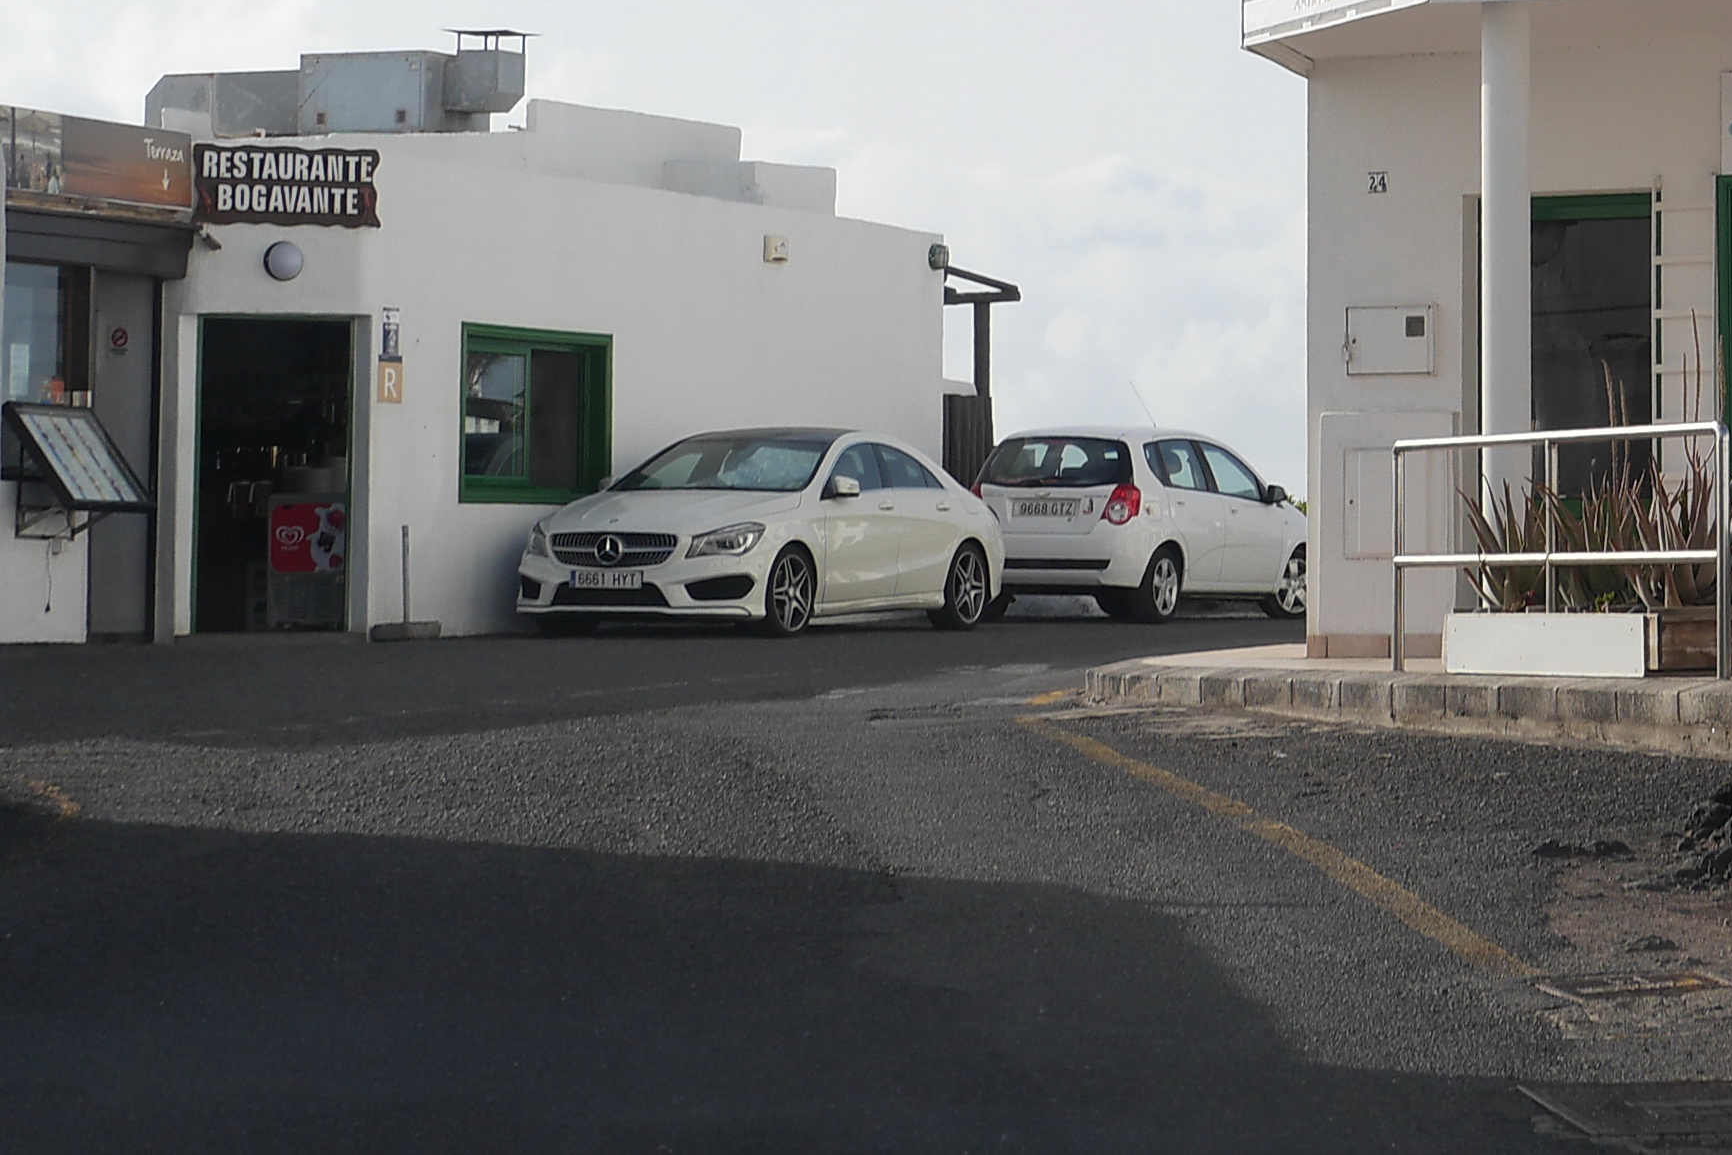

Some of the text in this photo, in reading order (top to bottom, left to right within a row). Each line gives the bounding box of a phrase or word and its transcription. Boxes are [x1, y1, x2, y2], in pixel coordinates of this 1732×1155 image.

[143, 138, 184, 164] Terraza
[202, 150, 374, 183] RESTAURANTE
[1369, 175, 1386, 192] 24
[217, 183, 359, 215] BOGAVANTE
[384, 367, 397, 398] R
[578, 572, 636, 586] 6661 HYT
